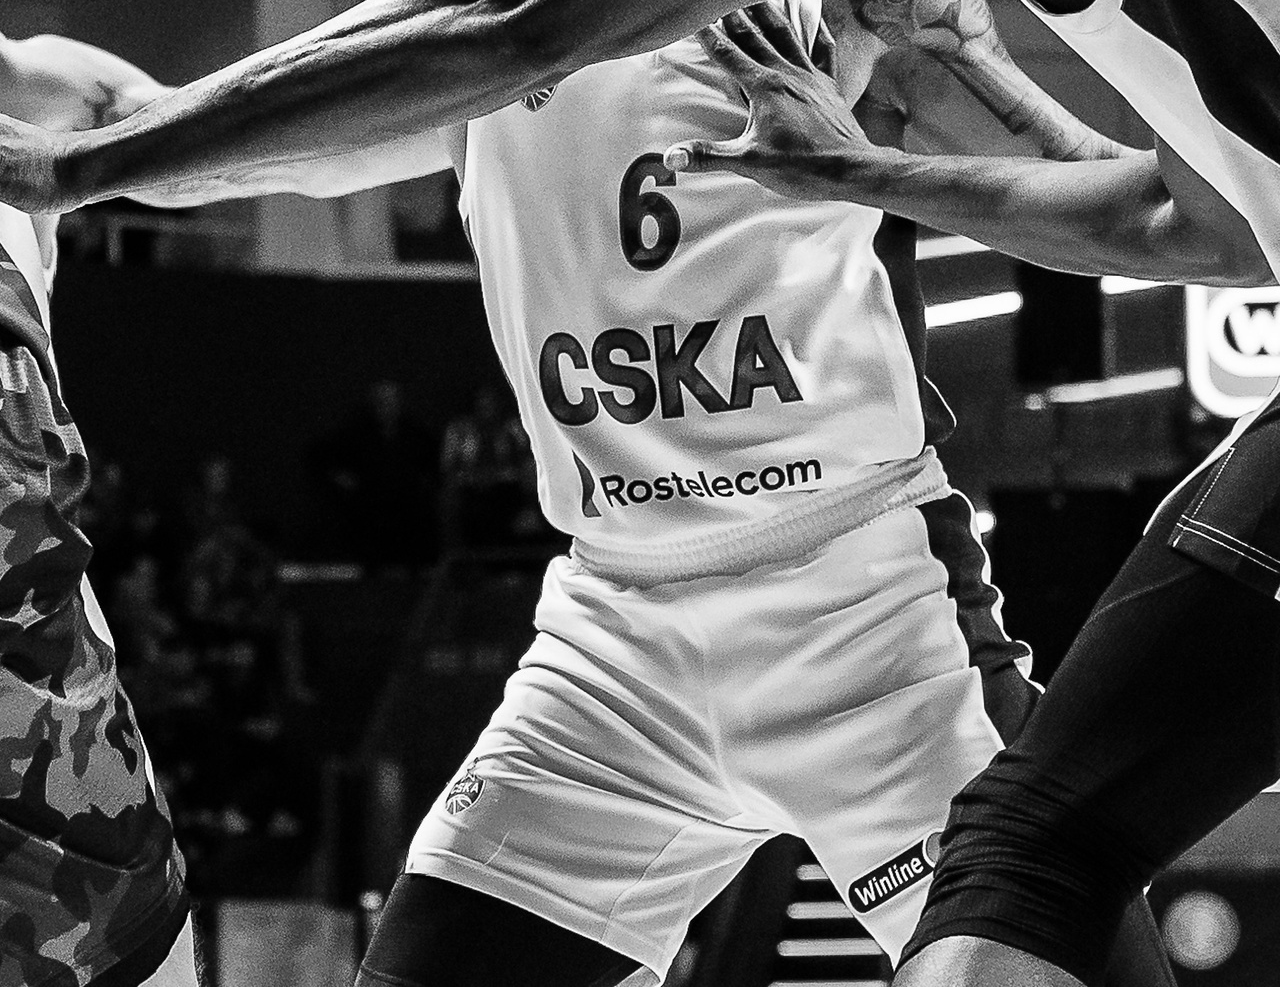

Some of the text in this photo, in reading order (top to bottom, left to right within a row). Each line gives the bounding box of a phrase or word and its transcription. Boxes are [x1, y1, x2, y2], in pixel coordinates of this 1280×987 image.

[618, 152, 682, 272] 6
[539, 315, 803, 426] CSKA
[599, 459, 822, 507] Rostelecom
[854, 857, 924, 906] Winline
